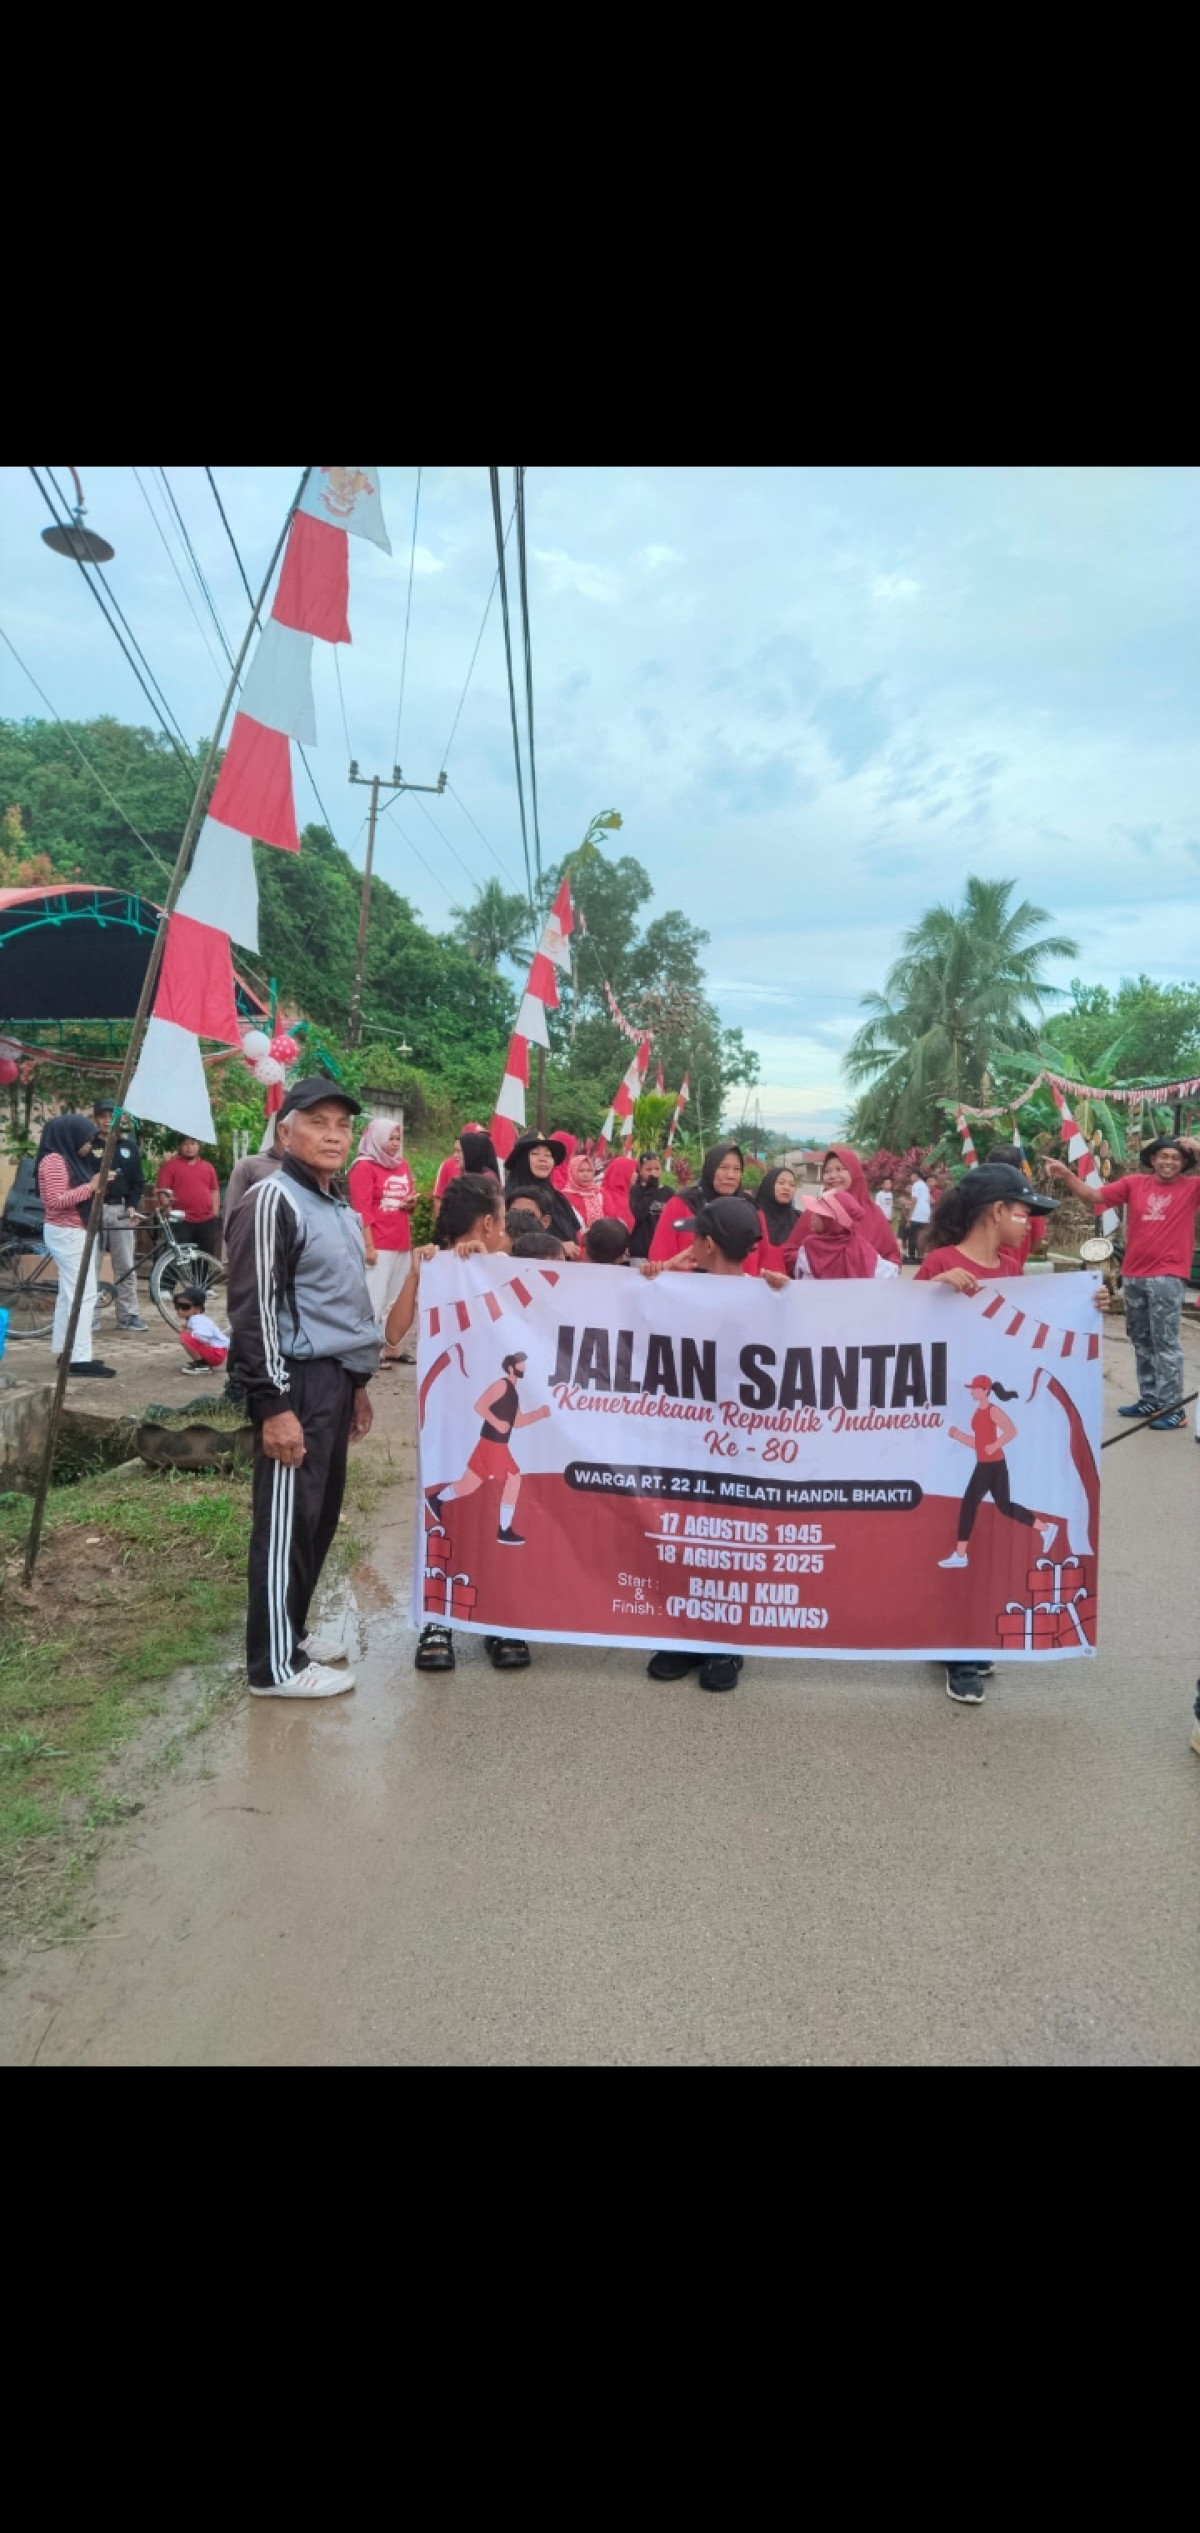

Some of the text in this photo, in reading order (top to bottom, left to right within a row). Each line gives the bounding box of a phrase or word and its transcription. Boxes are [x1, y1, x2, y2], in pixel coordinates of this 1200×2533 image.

[548, 1325, 947, 1410] JALAN SANTAI
[552, 1382, 943, 1435] Kemerdekaan Republik Indonesia
[703, 1430, 739, 1457] Ke
[761, 1437, 799, 1464] 80
[574, 1469, 912, 1503] WARGA RT. 22 JL. MELATI HANDIL BHAKTI
[660, 1512, 823, 1544] 17 AGUSTUS 1945
[656, 1544, 824, 1574] 18 AGUSTUS 2025
[634, 1588, 645, 1600] &
[689, 1577, 799, 1605] BALAI KUD
[666, 1595, 829, 1629] (POSKO DAWIS)
